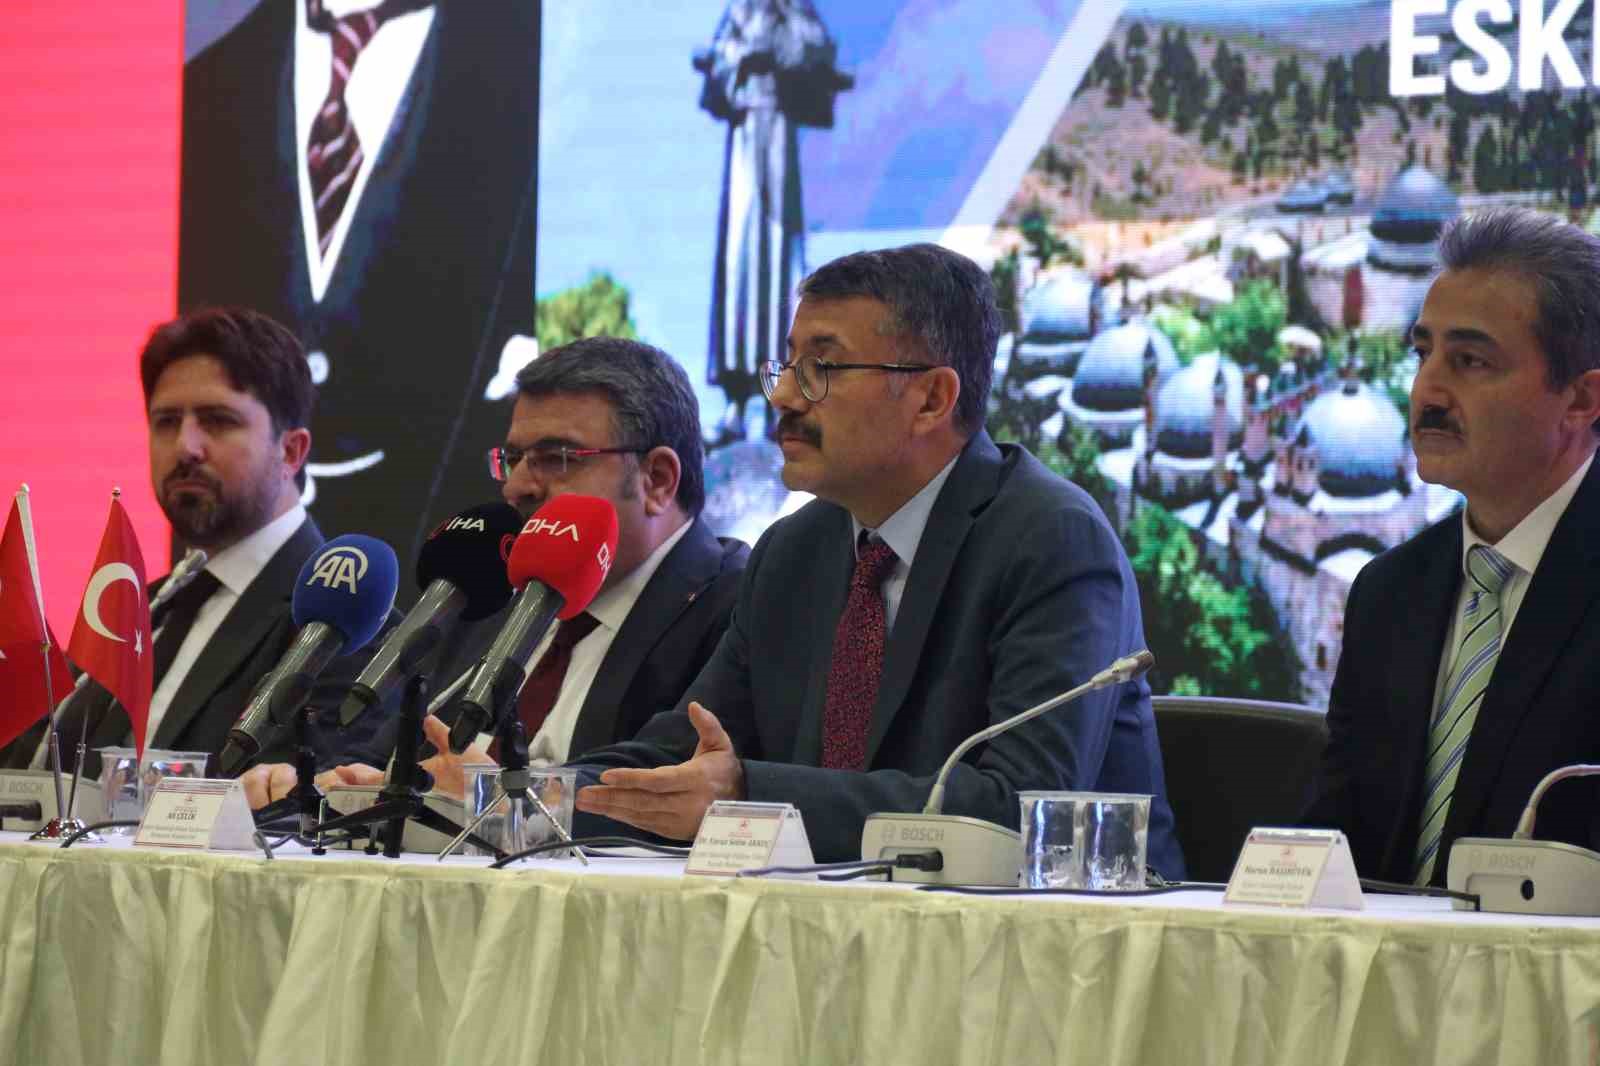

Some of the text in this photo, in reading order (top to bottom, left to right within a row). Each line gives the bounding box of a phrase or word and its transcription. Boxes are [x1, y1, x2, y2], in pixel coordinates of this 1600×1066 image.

[520, 518, 579, 542] DHA
[306, 555, 357, 594] AA
[901, 827, 945, 841] BOSCH
